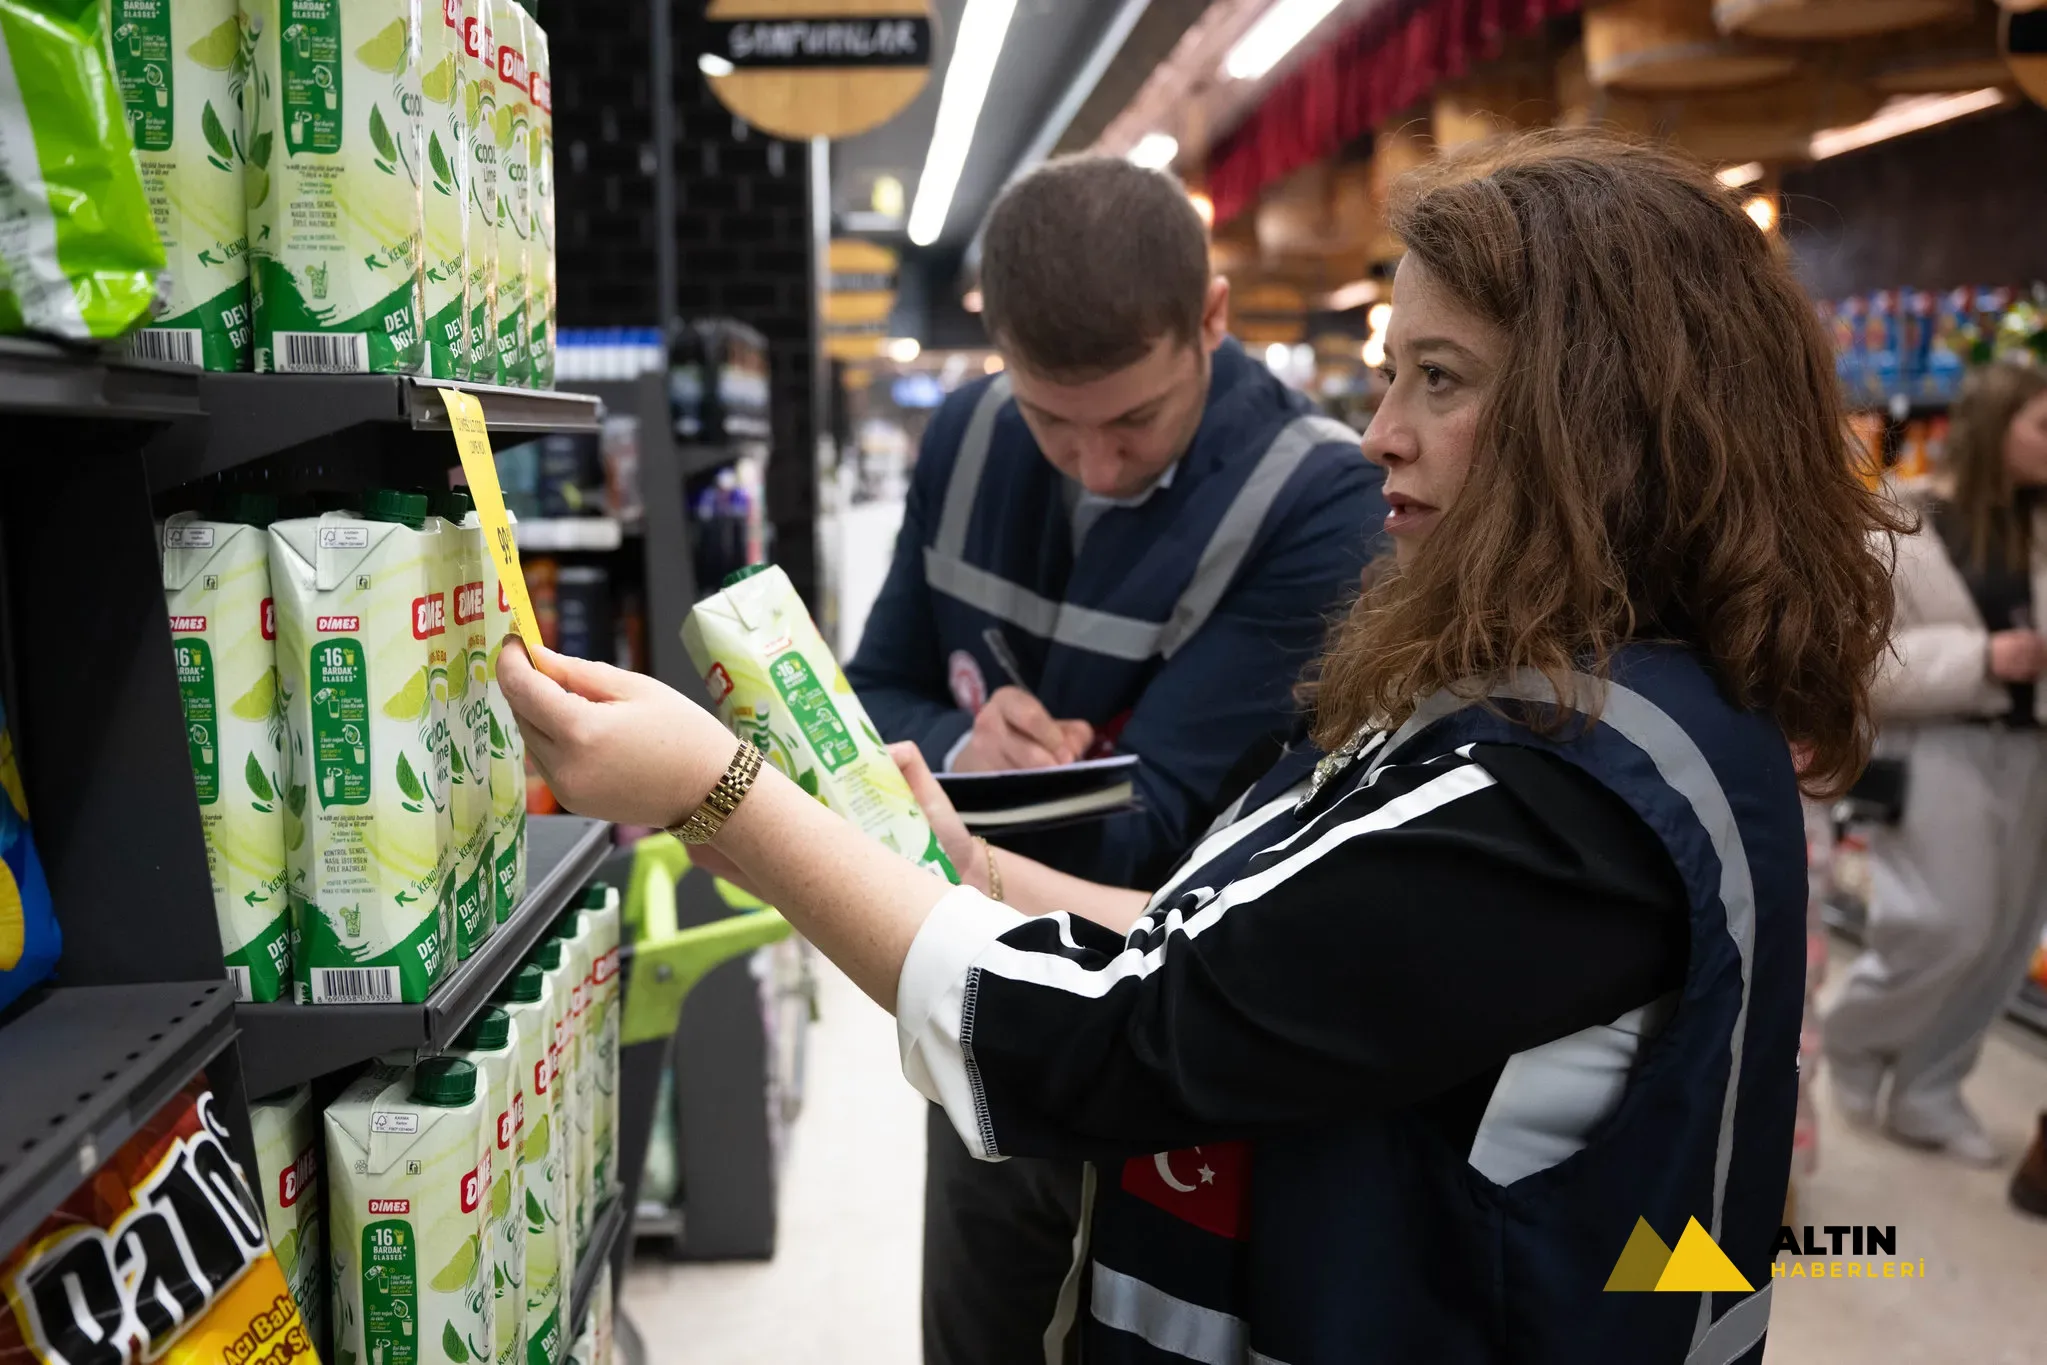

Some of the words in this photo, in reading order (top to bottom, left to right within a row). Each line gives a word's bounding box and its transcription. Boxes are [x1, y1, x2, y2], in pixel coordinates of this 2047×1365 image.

[384, 306, 410, 333] DEV
[389, 328, 415, 352] BOY
[498, 331, 517, 354] DEV
[318, 616, 358, 630] DİMES
[458, 892, 478, 920] DEV
[416, 930, 439, 960] DEV
[371, 1199, 408, 1212] DİMES
